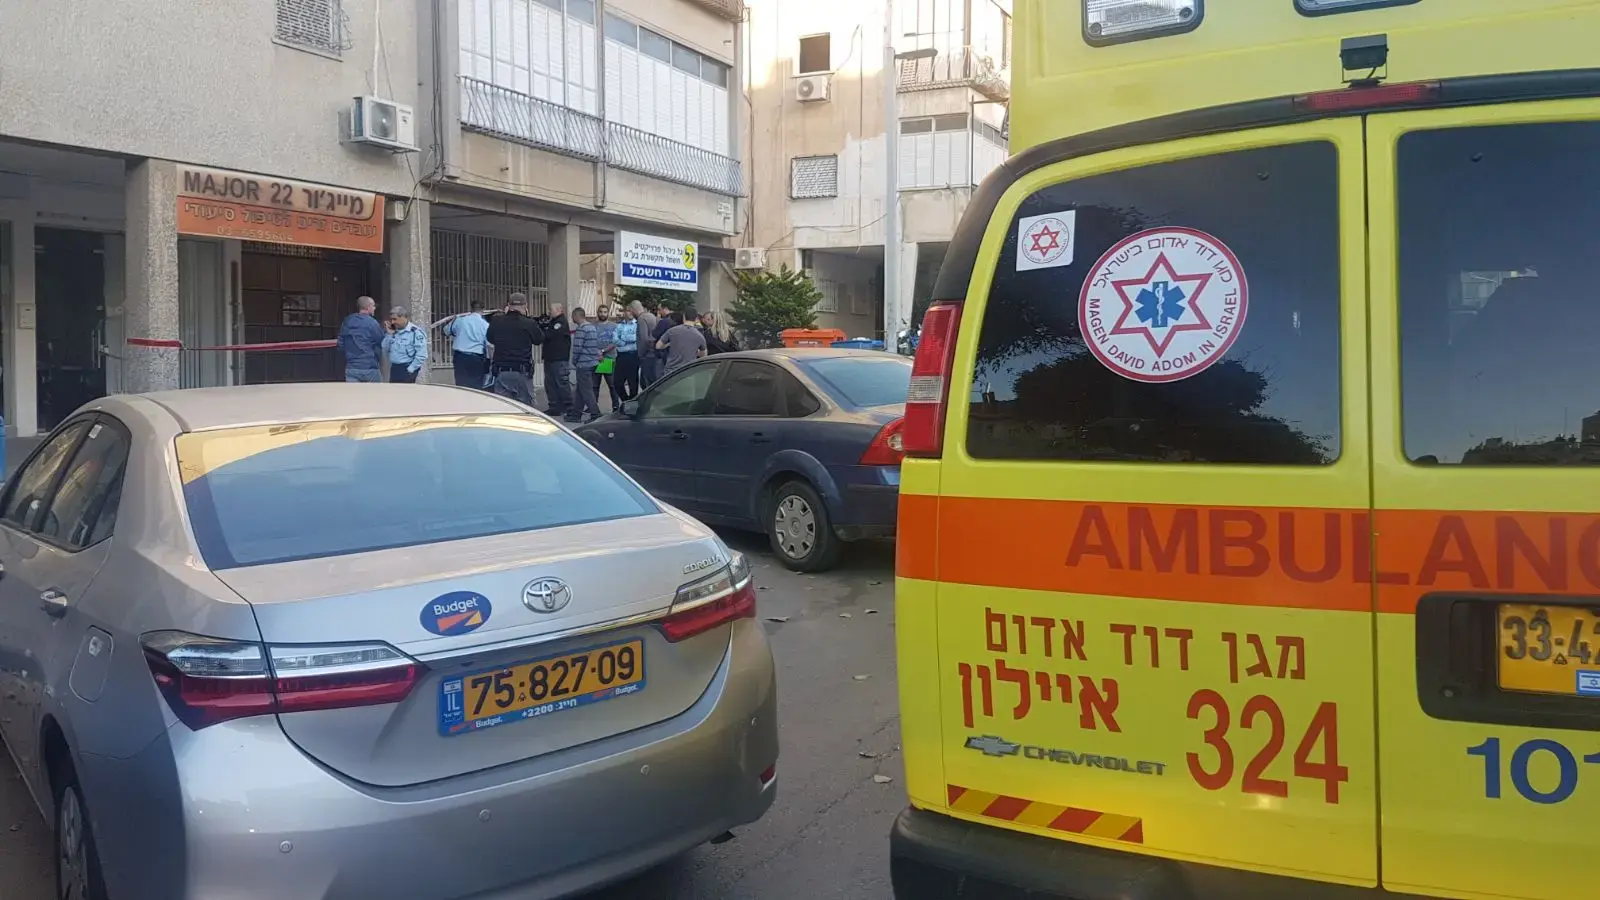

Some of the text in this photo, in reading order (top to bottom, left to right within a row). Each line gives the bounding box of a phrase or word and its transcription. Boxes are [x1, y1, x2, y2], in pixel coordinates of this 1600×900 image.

[184, 171, 261, 201] MAJOR
[270, 182, 293, 206] 22
[184, 202, 235, 221] סיעודי
[629, 264, 691, 281] מוצרי חשמל
[1092, 236, 1233, 289] מגן דוד אדום בישראל
[1089, 287, 1238, 372] MAGEN DAVID ADOM IN ISRAEL
[433, 597, 478, 616] Budget
[984, 607, 1306, 684] מגן דוד אדום
[447, 693, 461, 712] IL
[957, 659, 1122, 733] איילון
[1022, 744, 1167, 776] CHEVROLET
[1185, 688, 1349, 804] 324
